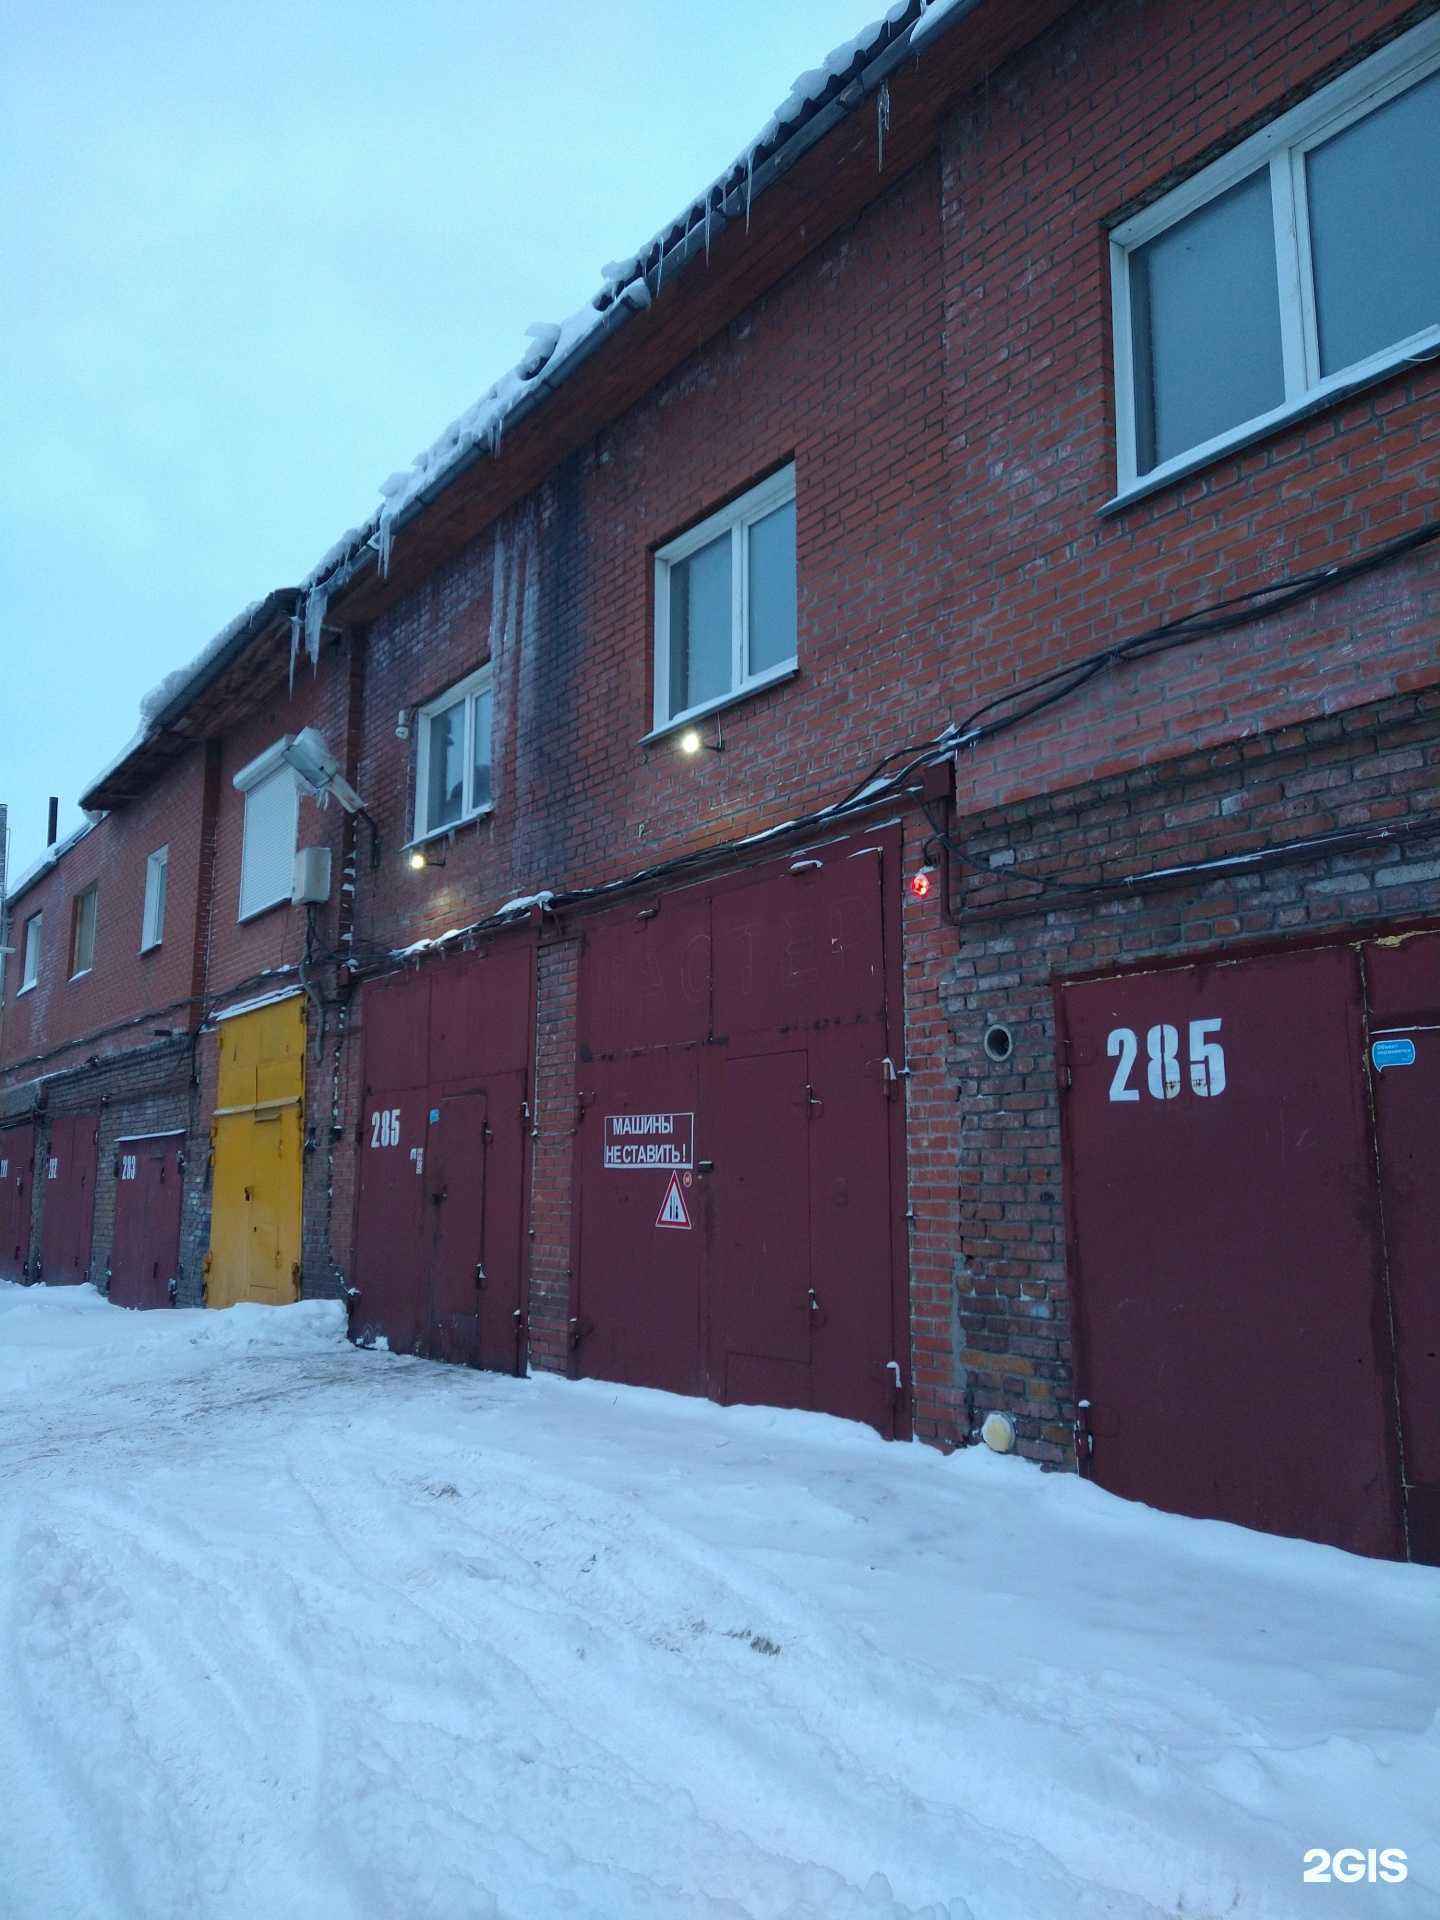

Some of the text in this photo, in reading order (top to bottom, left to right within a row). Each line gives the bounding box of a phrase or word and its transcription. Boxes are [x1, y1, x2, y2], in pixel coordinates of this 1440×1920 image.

[1107, 1018, 1226, 1101] 285
[371, 1109, 401, 1148] 285
[612, 1115, 674, 1135] МАШИНЫ
[605, 1145, 622, 1163] НЕ
